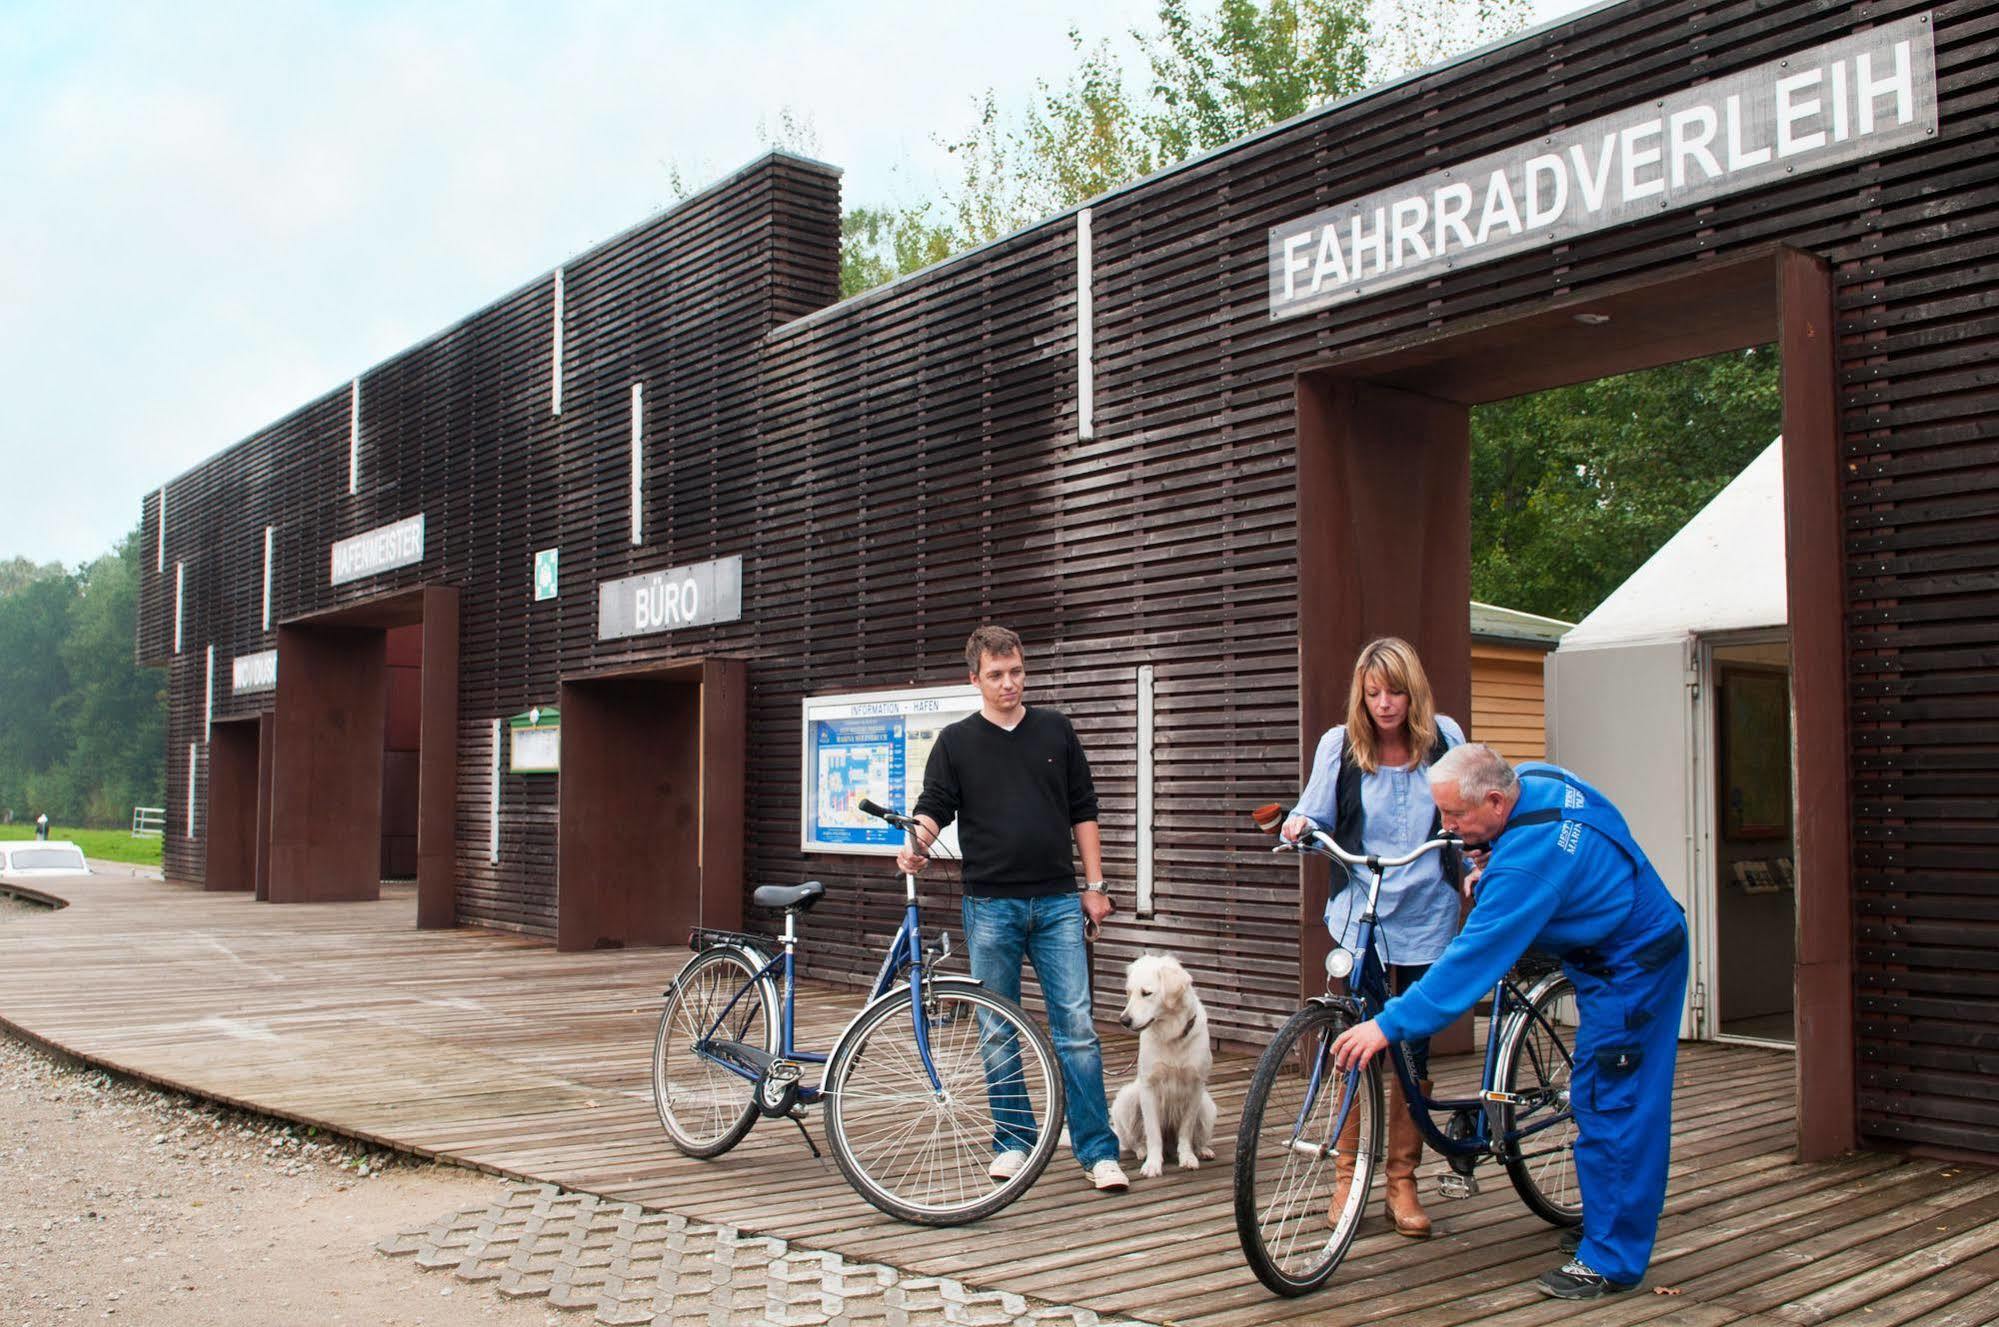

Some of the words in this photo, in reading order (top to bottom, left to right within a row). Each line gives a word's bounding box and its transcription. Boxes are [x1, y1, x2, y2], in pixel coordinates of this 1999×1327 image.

[1282, 40, 1914, 300] FAHRRADVERLEIH
[333, 523, 421, 577] HAFENMEISTER
[635, 577, 698, 629] BÜRO
[851, 702, 899, 716] INFORMATION
[913, 700, 939, 712] HAFEN
[1557, 822, 1571, 848] BEST
